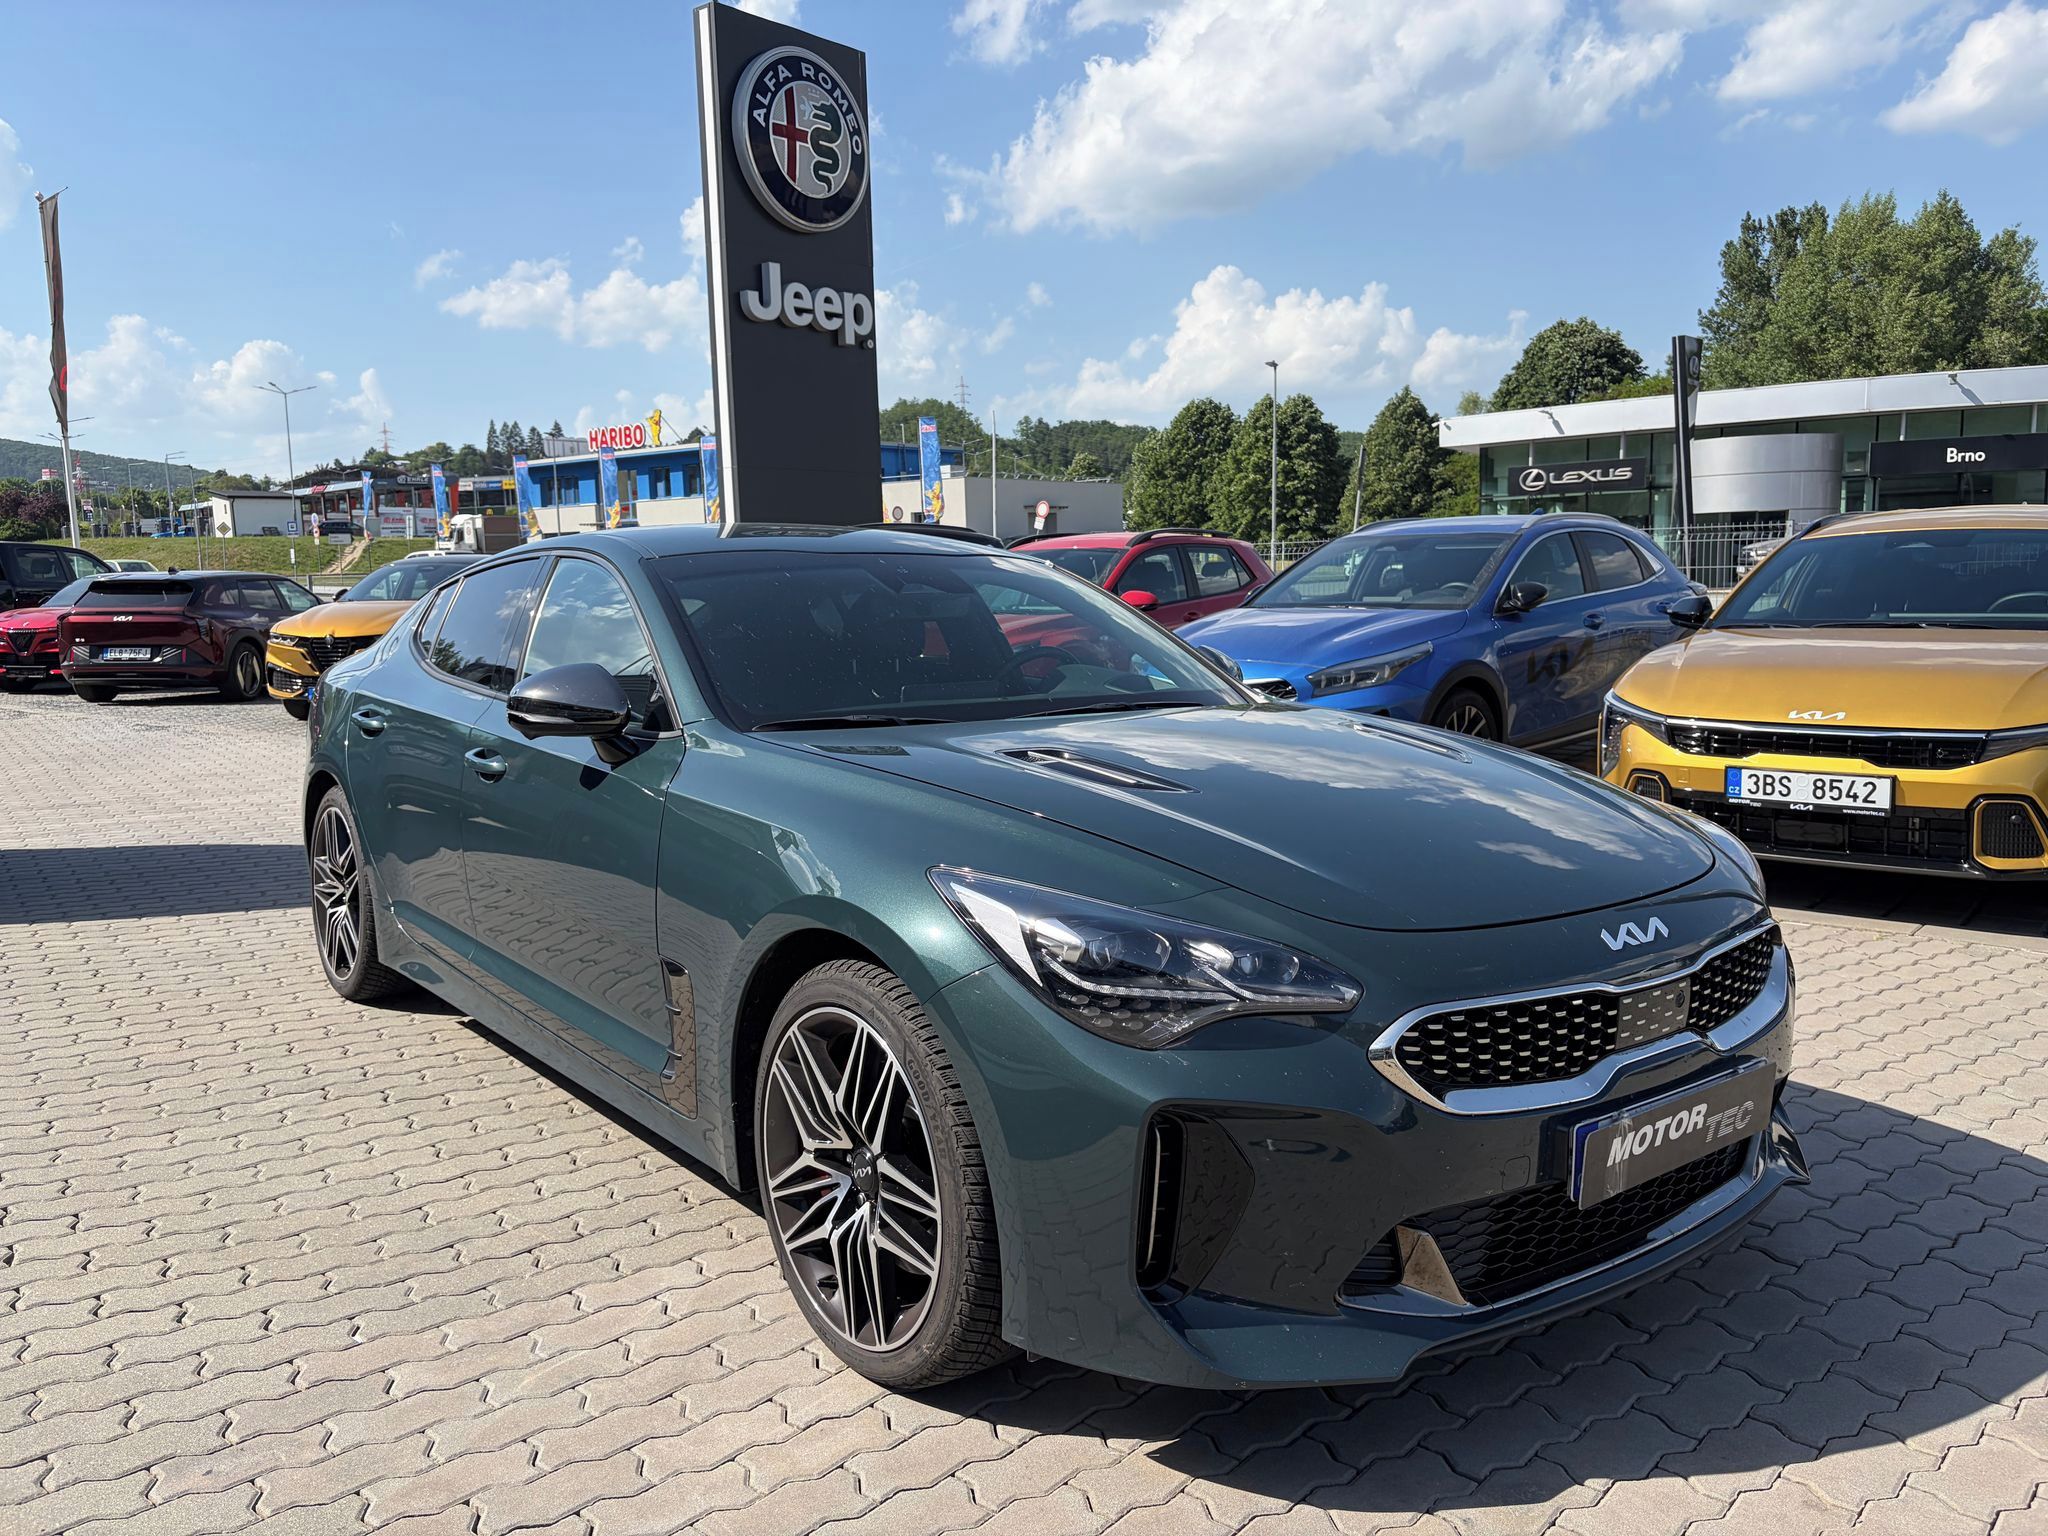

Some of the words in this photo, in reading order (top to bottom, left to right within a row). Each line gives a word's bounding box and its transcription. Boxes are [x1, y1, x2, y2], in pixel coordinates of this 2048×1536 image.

[753, 64, 793, 127] ALFA
[800, 61, 863, 156] ROMEO
[740, 262, 873, 345] Jeep
[589, 425, 645, 451] HARIBO
[1945, 447, 1986, 464] Brno
[1549, 467, 1632, 484] LEXUS
[1788, 710, 1845, 720] KIA
[1729, 786, 1740, 794] CZ
[1746, 773, 1792, 798] 3BS
[1811, 779, 1876, 804] 8542
[1790, 803, 1813, 811] KIA
[1600, 916, 1669, 951] KIA
